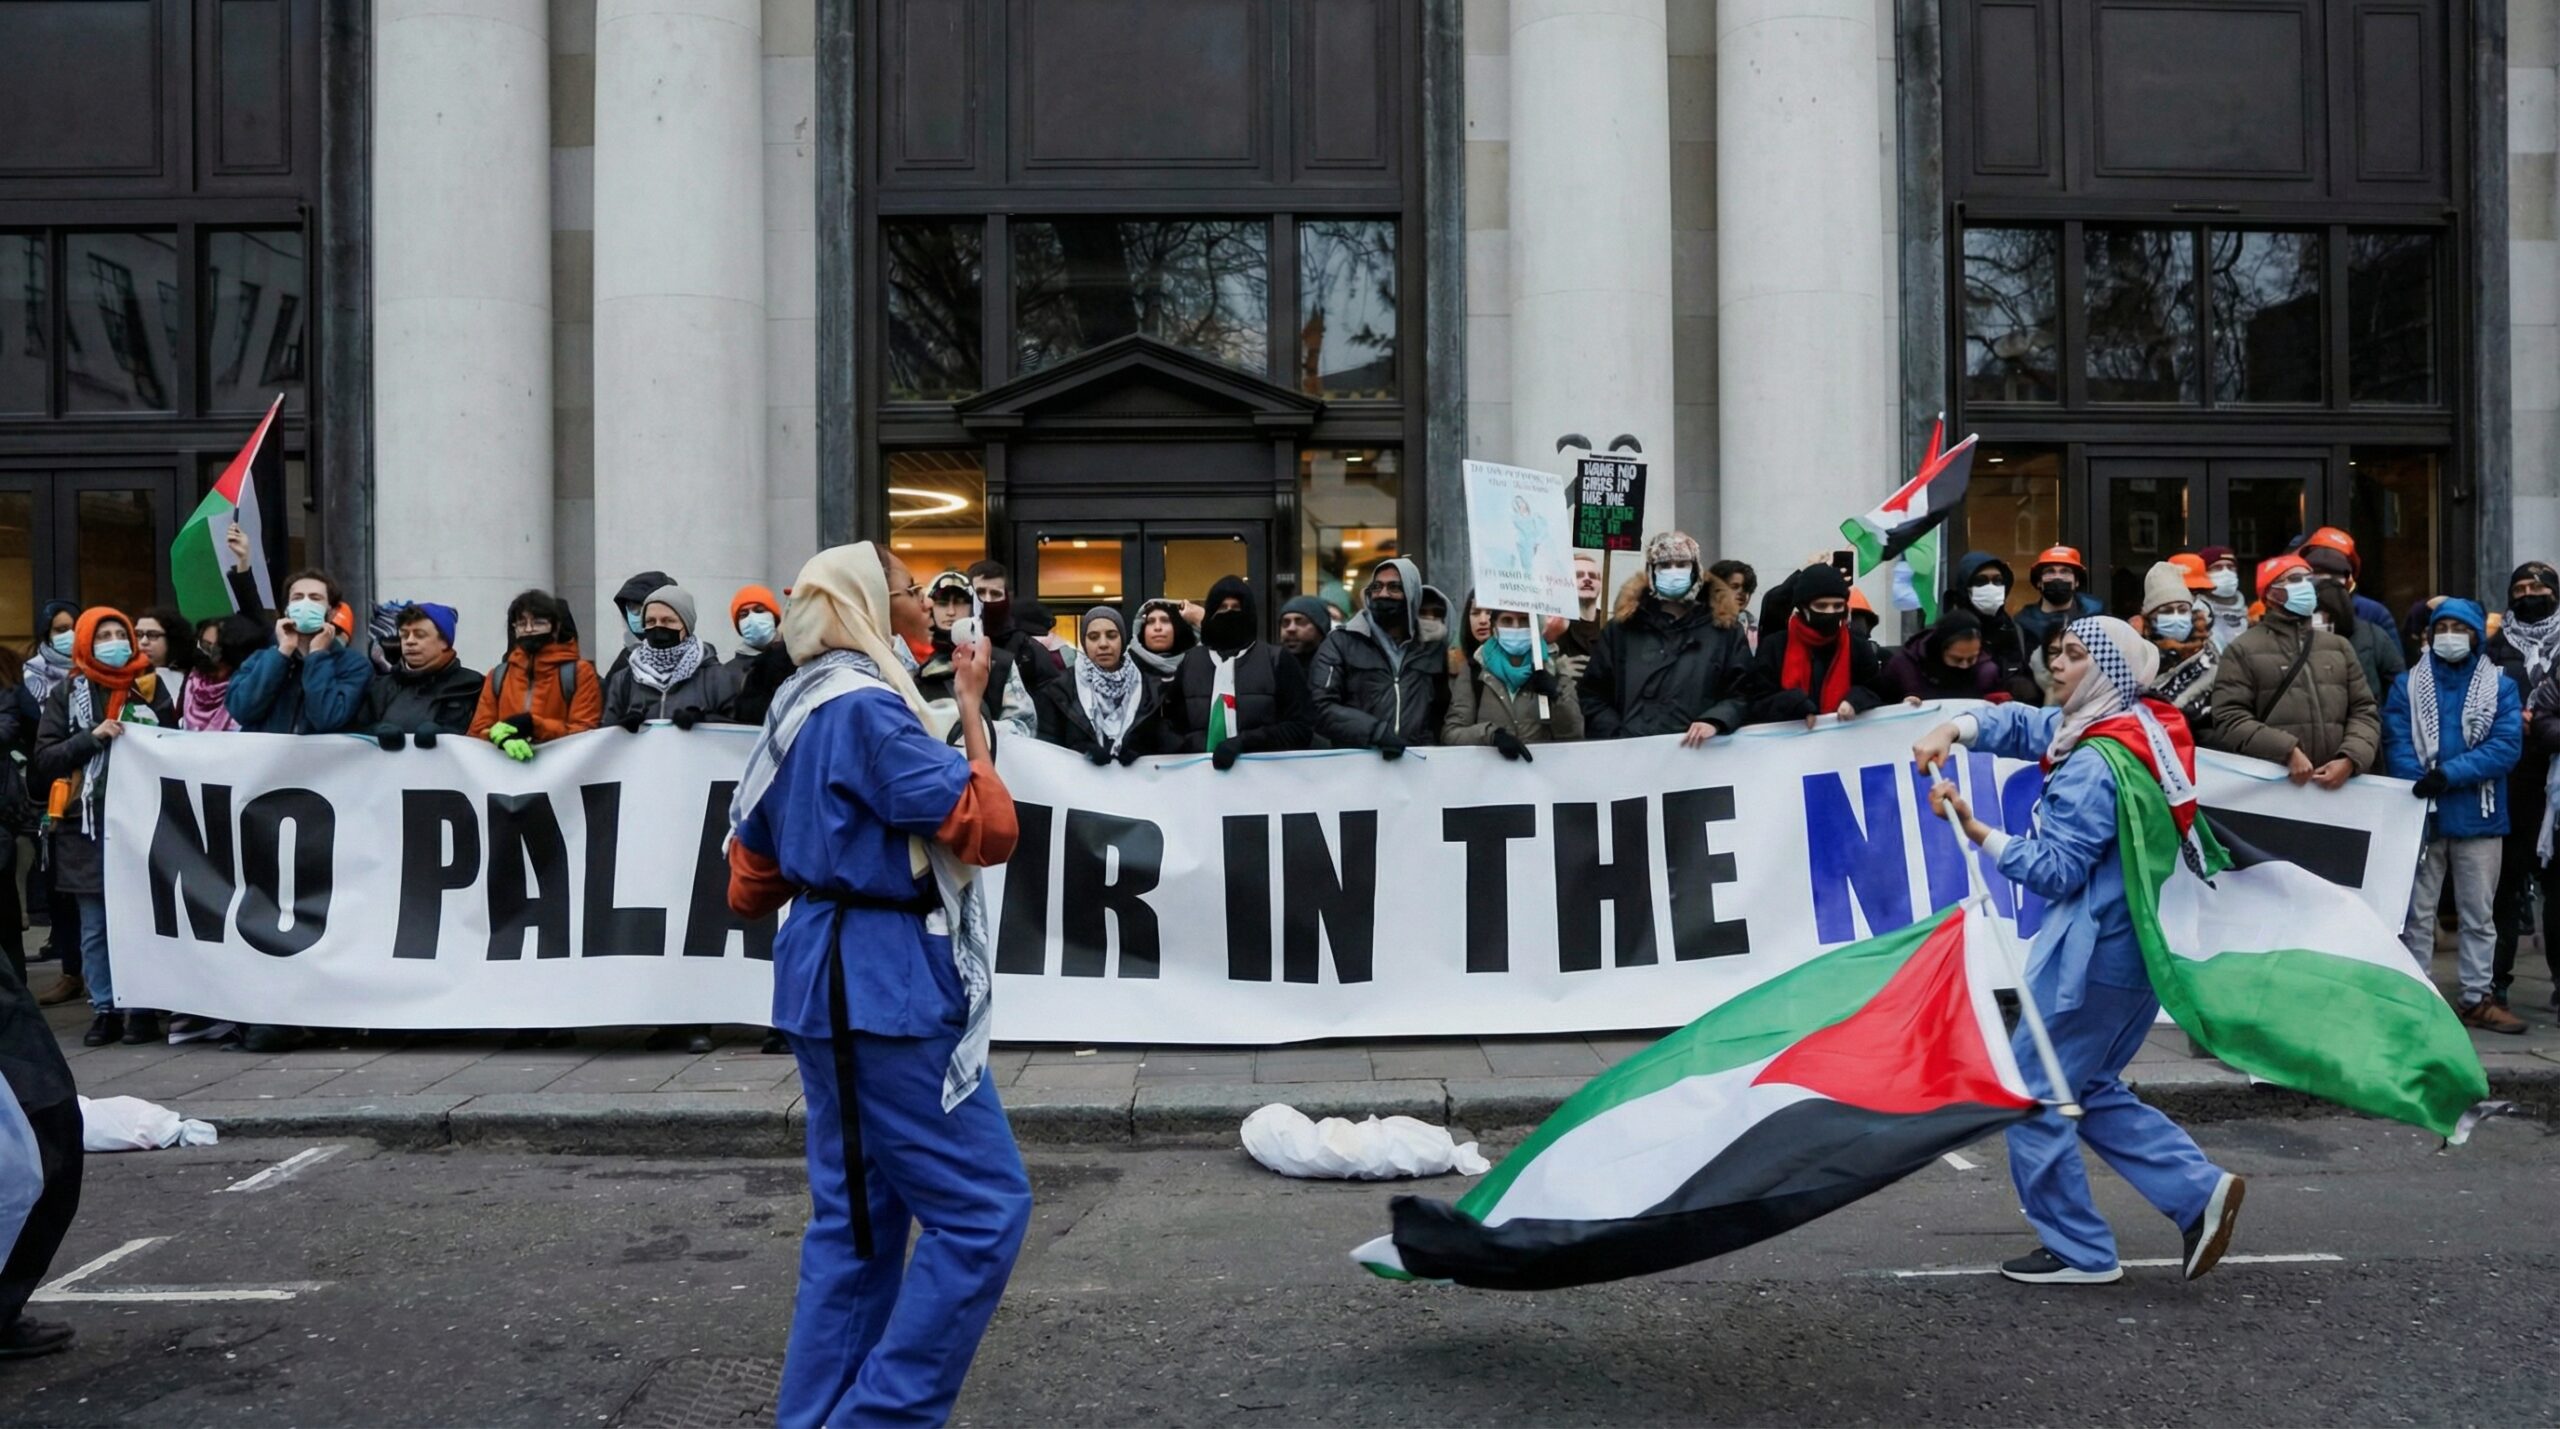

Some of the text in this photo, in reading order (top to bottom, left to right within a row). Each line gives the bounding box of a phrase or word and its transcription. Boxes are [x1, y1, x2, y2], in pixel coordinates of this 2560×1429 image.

[148, 777, 335, 958] NO
[393, 781, 1163, 979] PALAIR
[1223, 803, 1377, 984] IN
[1443, 786, 1750, 973] THE
